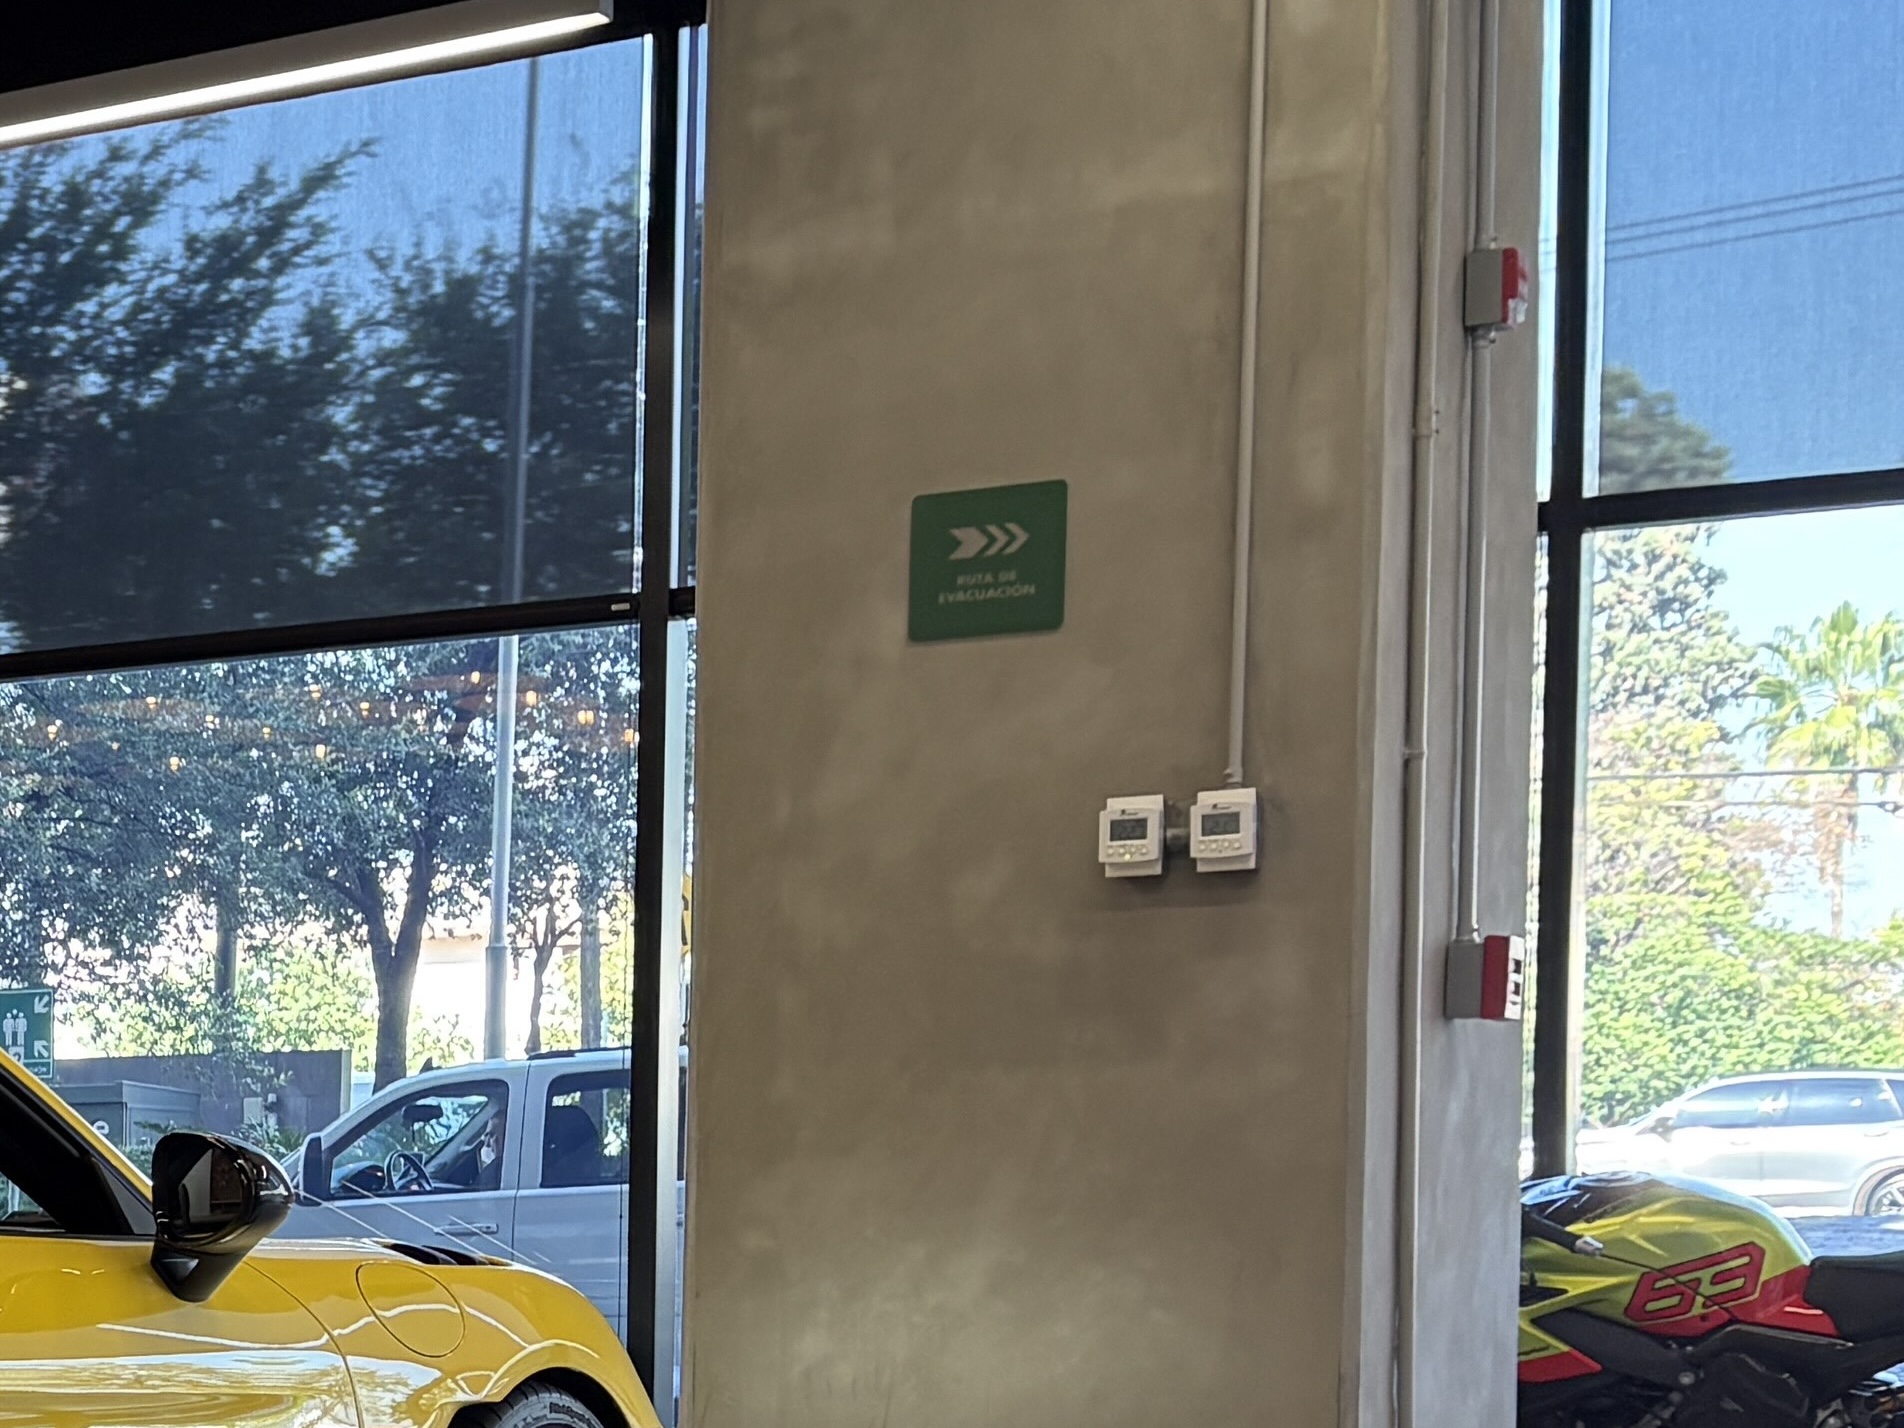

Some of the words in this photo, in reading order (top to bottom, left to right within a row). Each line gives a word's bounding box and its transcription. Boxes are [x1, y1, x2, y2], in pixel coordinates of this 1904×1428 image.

[956, 573, 993, 585] RUTA
[998, 570, 1017, 582] DE
[938, 582, 1036, 604] EVACUACIÓN
